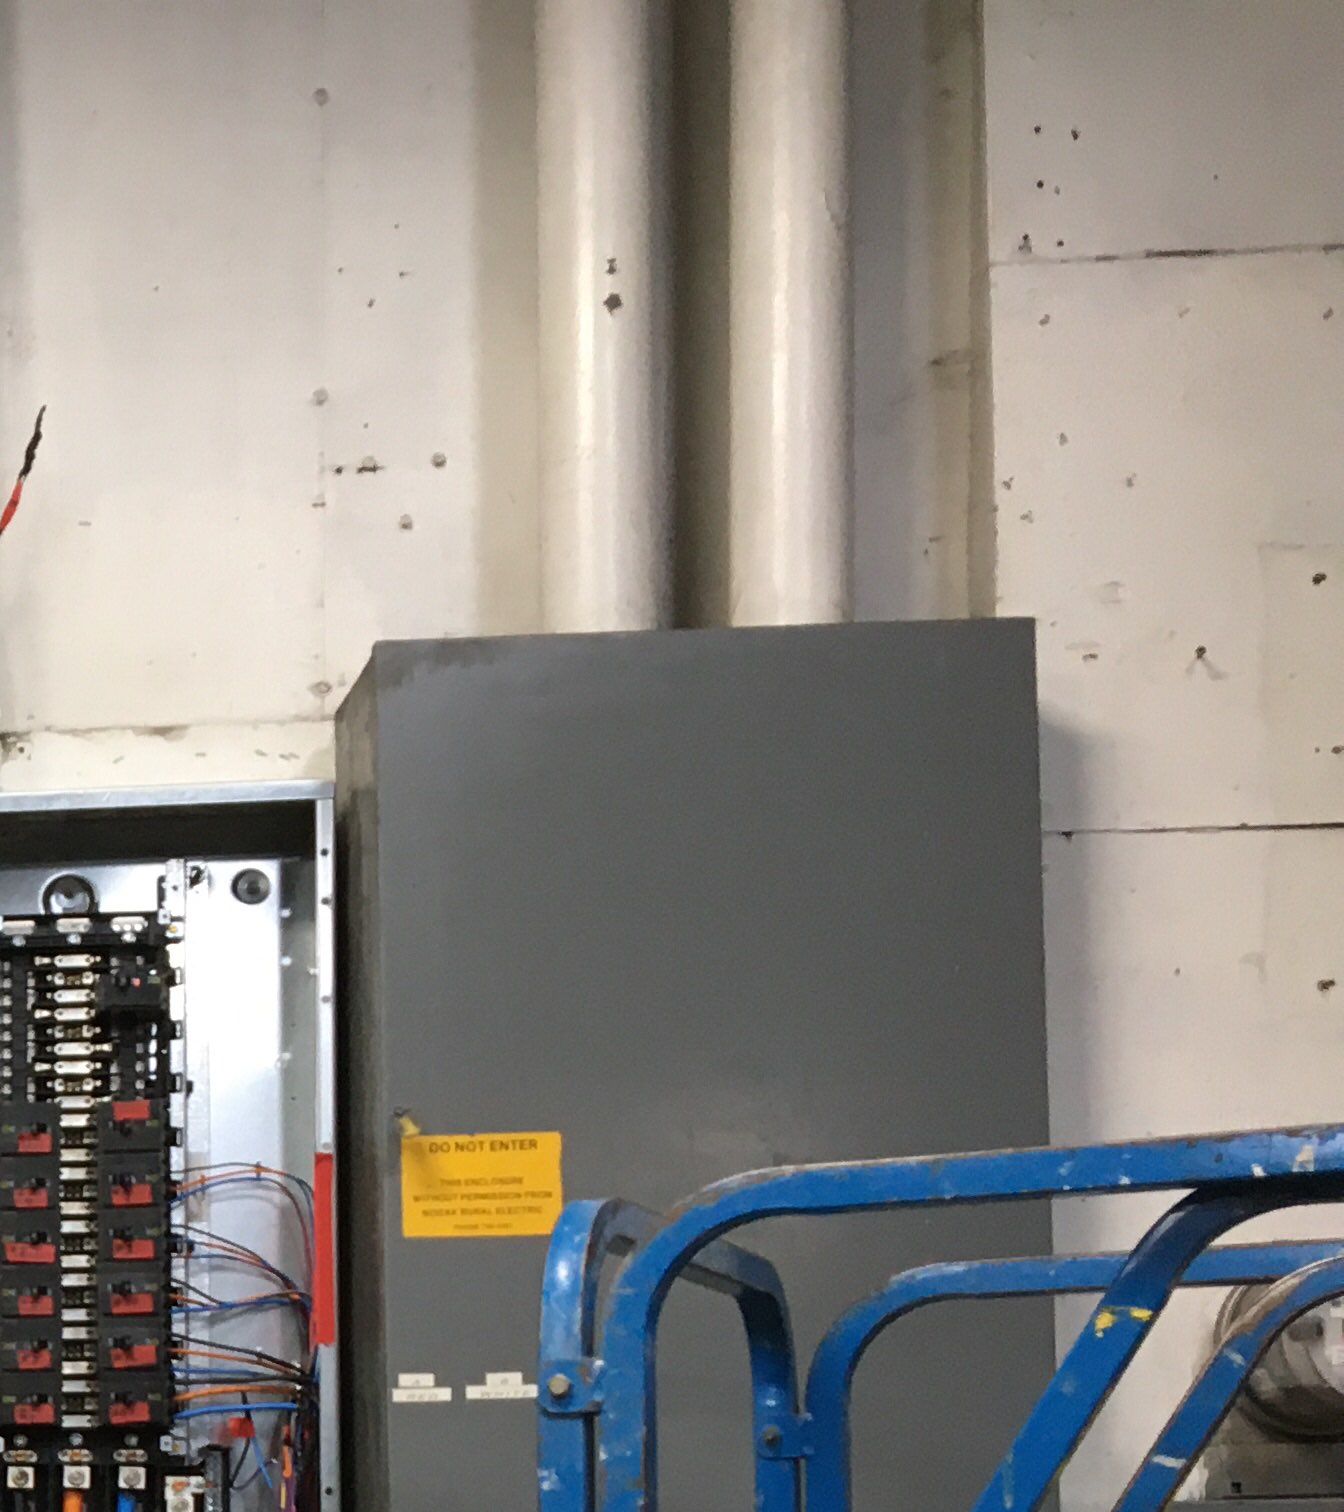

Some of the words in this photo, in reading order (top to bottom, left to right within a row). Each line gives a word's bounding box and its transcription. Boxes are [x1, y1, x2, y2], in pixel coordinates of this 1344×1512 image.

[429, 1141, 450, 1154] DO
[454, 1140, 485, 1153] NOT
[489, 1138, 538, 1153] ENTER
